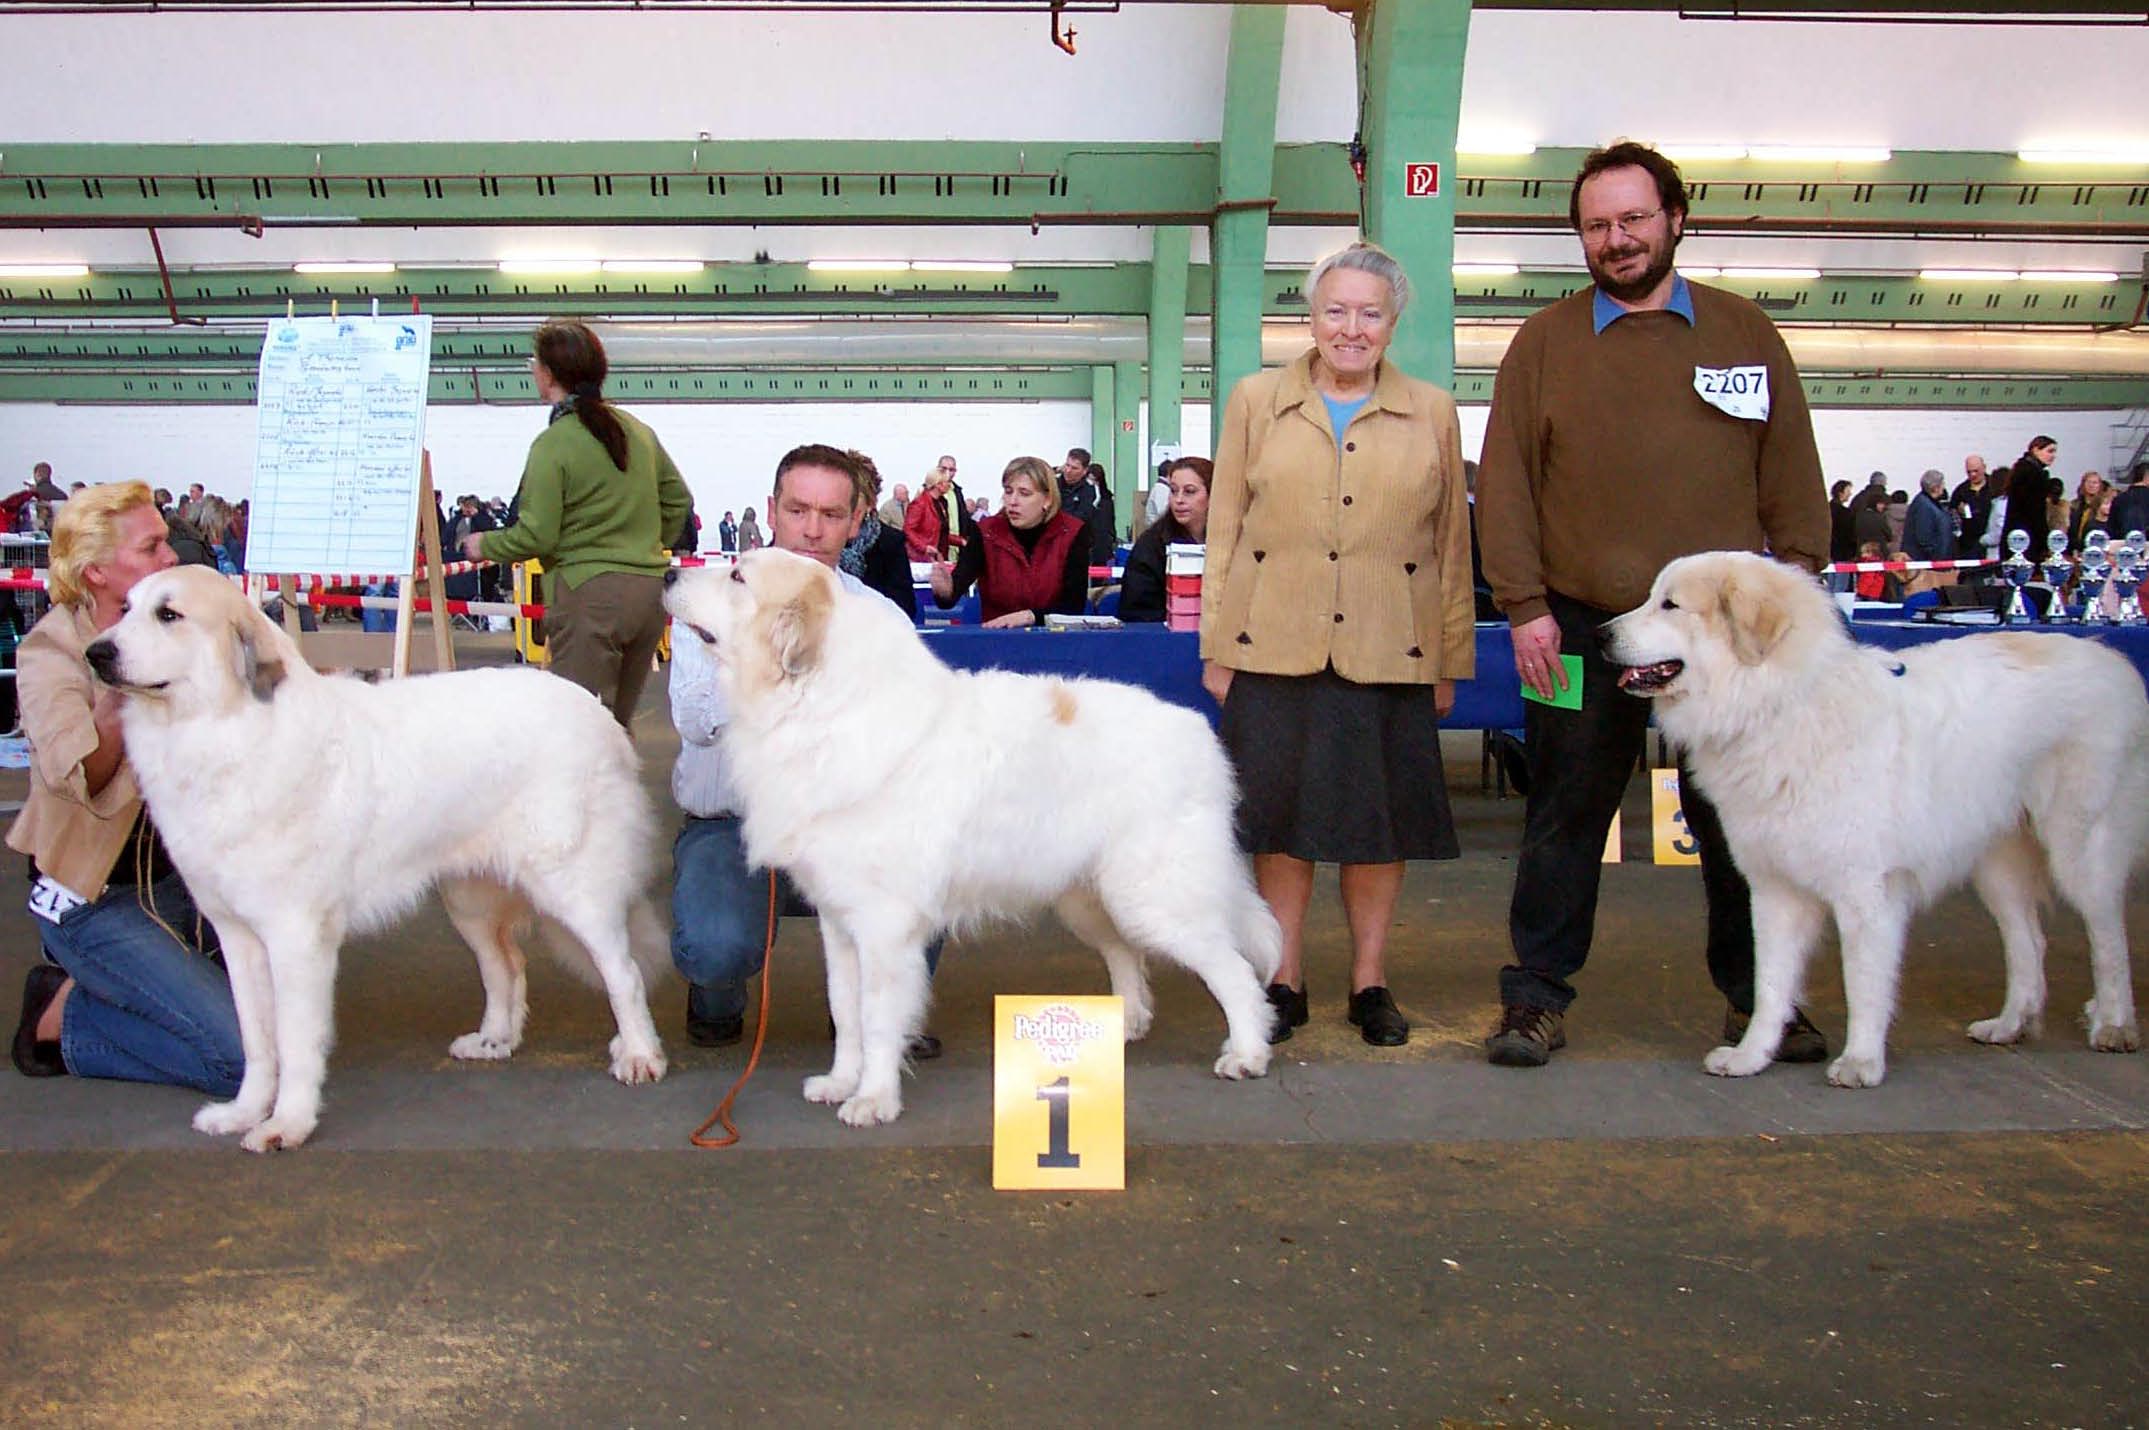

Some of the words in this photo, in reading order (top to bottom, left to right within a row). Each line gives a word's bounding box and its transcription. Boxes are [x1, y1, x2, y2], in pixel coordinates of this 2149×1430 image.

[1702, 373, 1763, 394] 2207
[1672, 810, 1700, 855] 3
[1014, 1015, 1104, 1043] Pedigree
[1037, 1076, 1080, 1169] 1
